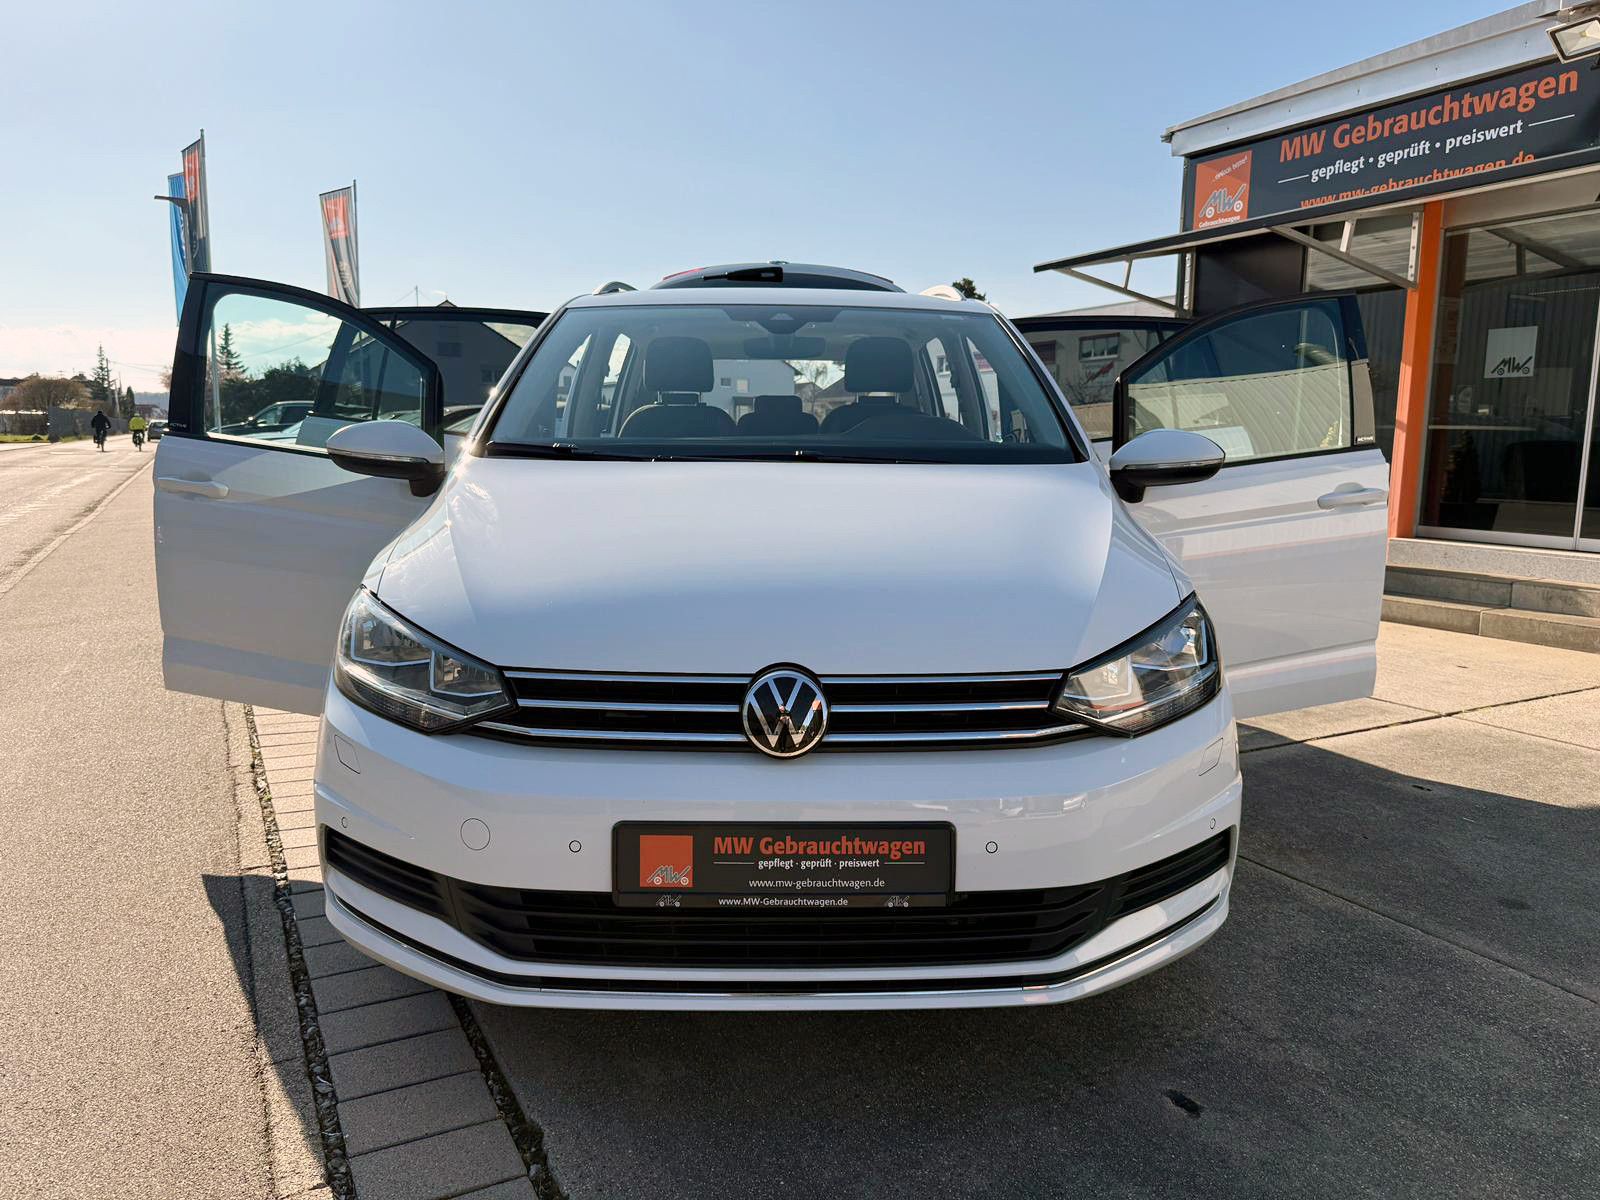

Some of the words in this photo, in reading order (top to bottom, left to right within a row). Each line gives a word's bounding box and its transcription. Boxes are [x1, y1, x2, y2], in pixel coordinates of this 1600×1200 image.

[1280, 129, 1327, 163] MW
[1333, 69, 1578, 149] Gebrauchtwagen
[1311, 155, 1365, 182] gepflegt
[1377, 140, 1430, 168] geprüft
[1445, 119, 1524, 153] preiswert
[1300, 149, 1536, 208] wwwmw-gebrauchtwagende
[744, 674, 826, 753] VW
[713, 836, 754, 854] MW
[759, 835, 926, 860] Gebrauchtwagen
[758, 859, 794, 870] gepflegt
[800, 858, 832, 870] geprüft
[839, 859, 880, 870] preiswert
[718, 897, 849, 908] www.MW-Gebrauchtwagen.de
[748, 878, 885, 889] www.mw-gebrauchtwagen.de
